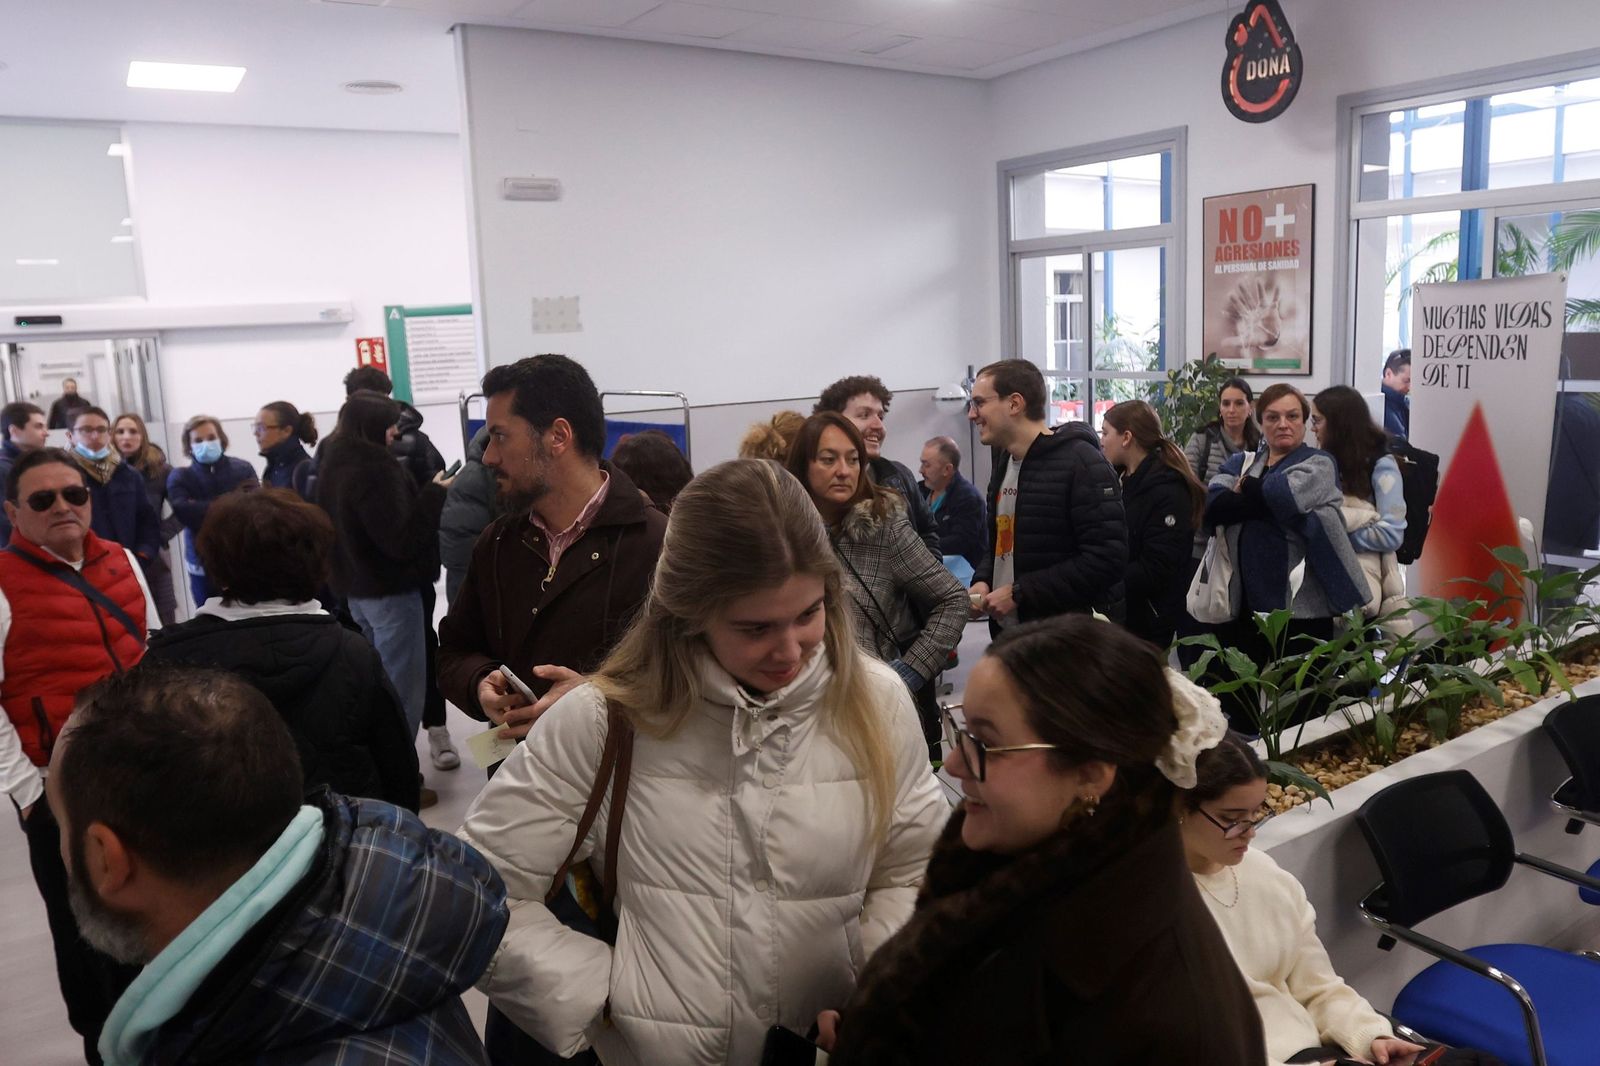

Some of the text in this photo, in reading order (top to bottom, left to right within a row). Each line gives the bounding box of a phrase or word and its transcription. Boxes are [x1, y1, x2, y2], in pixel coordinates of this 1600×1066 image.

[1246, 53, 1291, 81] DONA
[1215, 239, 1300, 263] AGRESIONES
[1215, 259, 1300, 274] AL PERSONAL DE SANIDAD
[1423, 300, 1552, 330] MUCHAS VIDAS
[1422, 333, 1528, 361] DEPENDEN
[1421, 363, 1473, 389] DE TI
